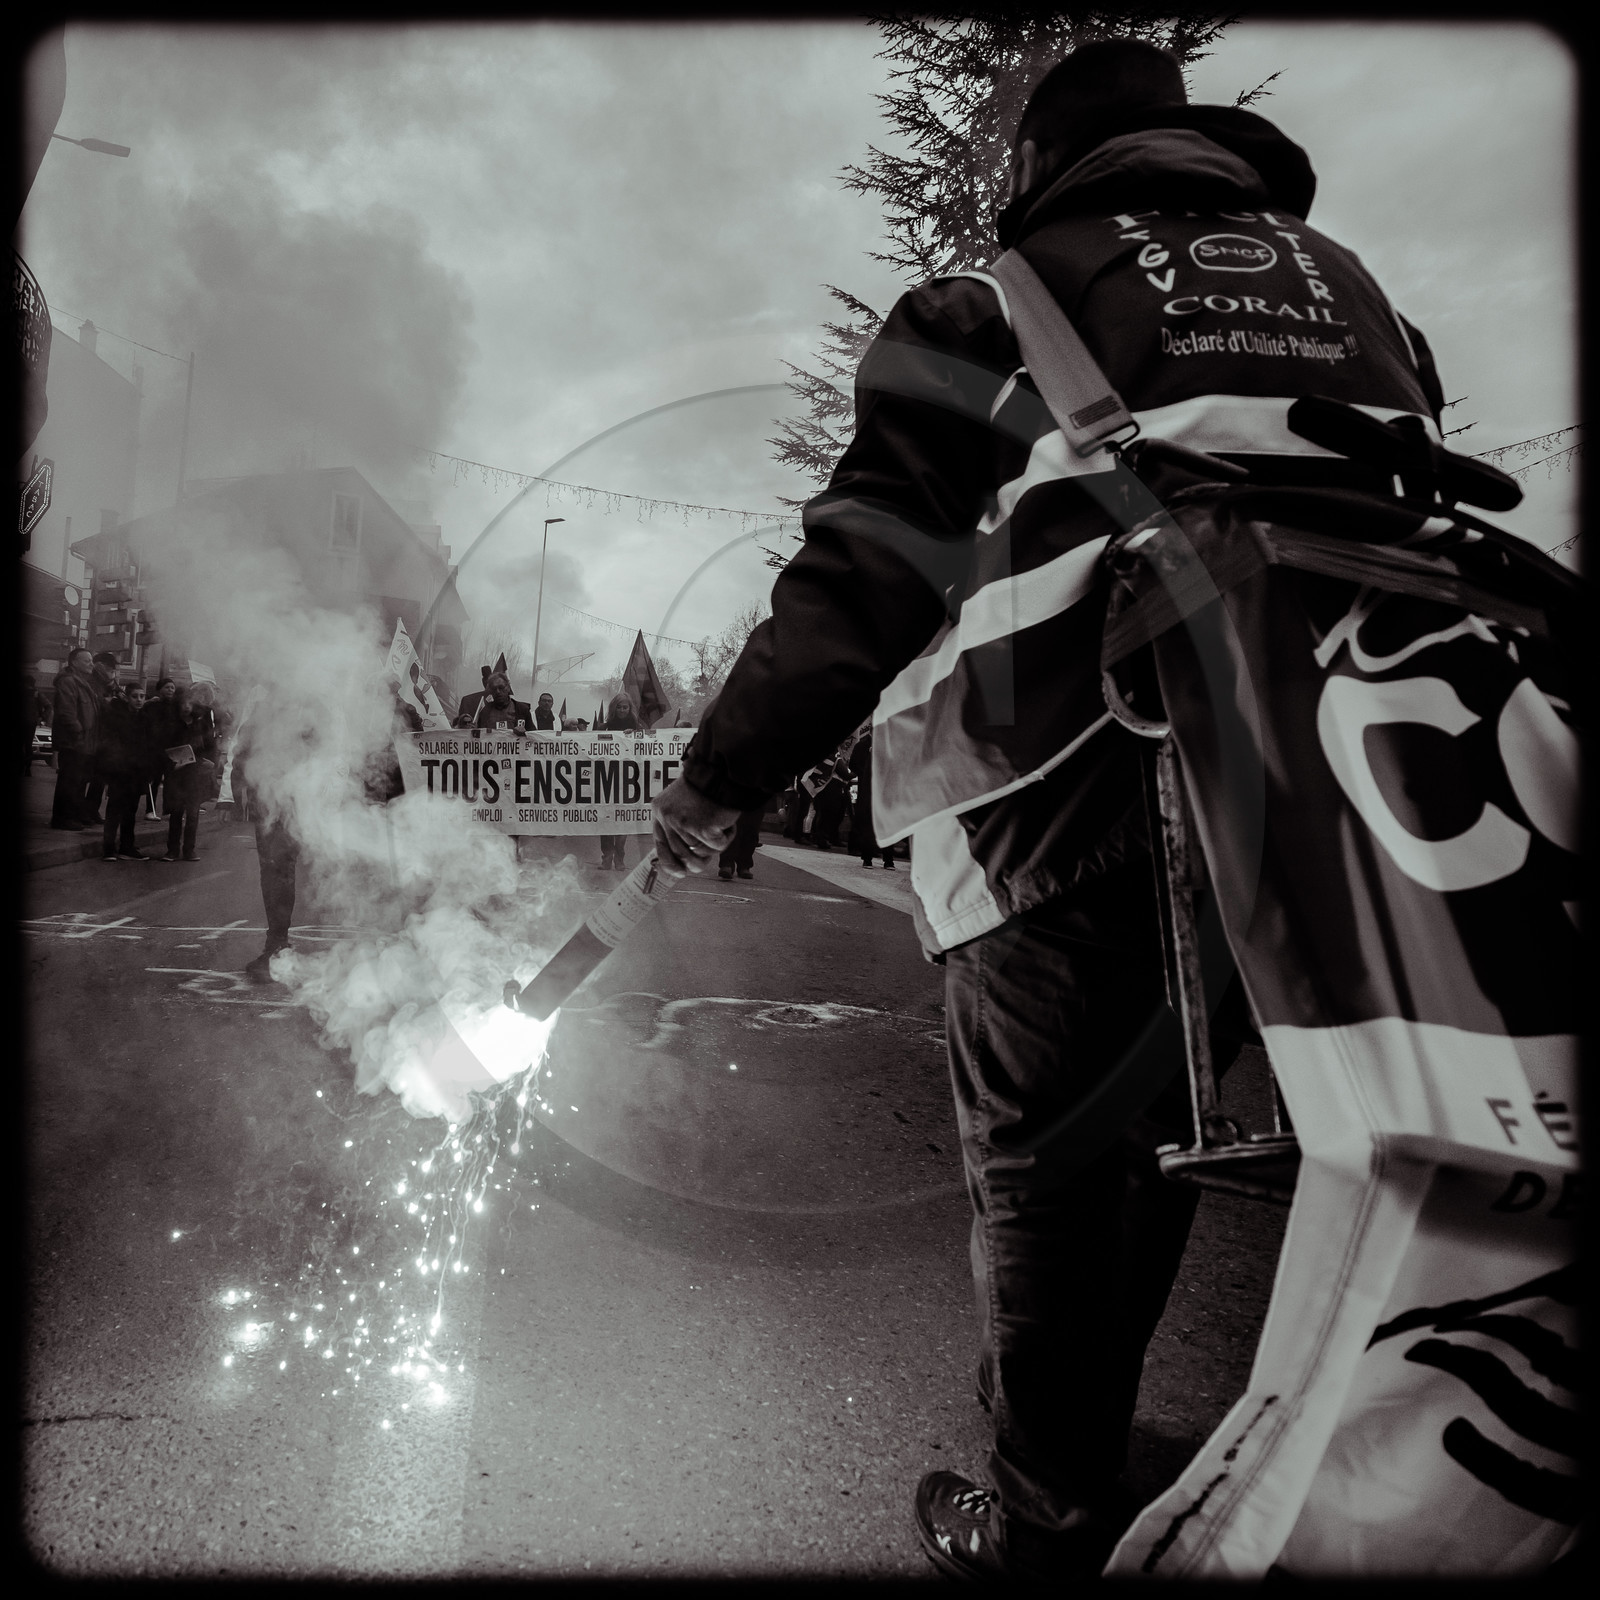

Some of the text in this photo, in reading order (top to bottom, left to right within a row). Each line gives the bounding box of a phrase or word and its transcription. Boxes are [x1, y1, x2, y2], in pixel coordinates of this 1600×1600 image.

[1199, 244, 1271, 261] SNCF
[1276, 231, 1335, 302] TER
[1163, 295, 1348, 326] CORAIL
[1161, 327, 1225, 356] Déclaré
[1228, 330, 1288, 356] d'Utilité
[1288, 334, 1345, 365] Publique
[26, 480, 44, 518] TABAC
[419, 740, 459, 755] SALARIÉS
[533, 740, 579, 756] RETRAITÉS
[588, 743, 620, 756] JEUNES
[634, 740, 664, 756] PRIVÉS
[420, 759, 680, 805] TOUS ENSEMBLE
[472, 808, 503, 822] EMPLOI
[518, 809, 558, 822] SERVICES
[563, 809, 598, 822] PUBLICS
